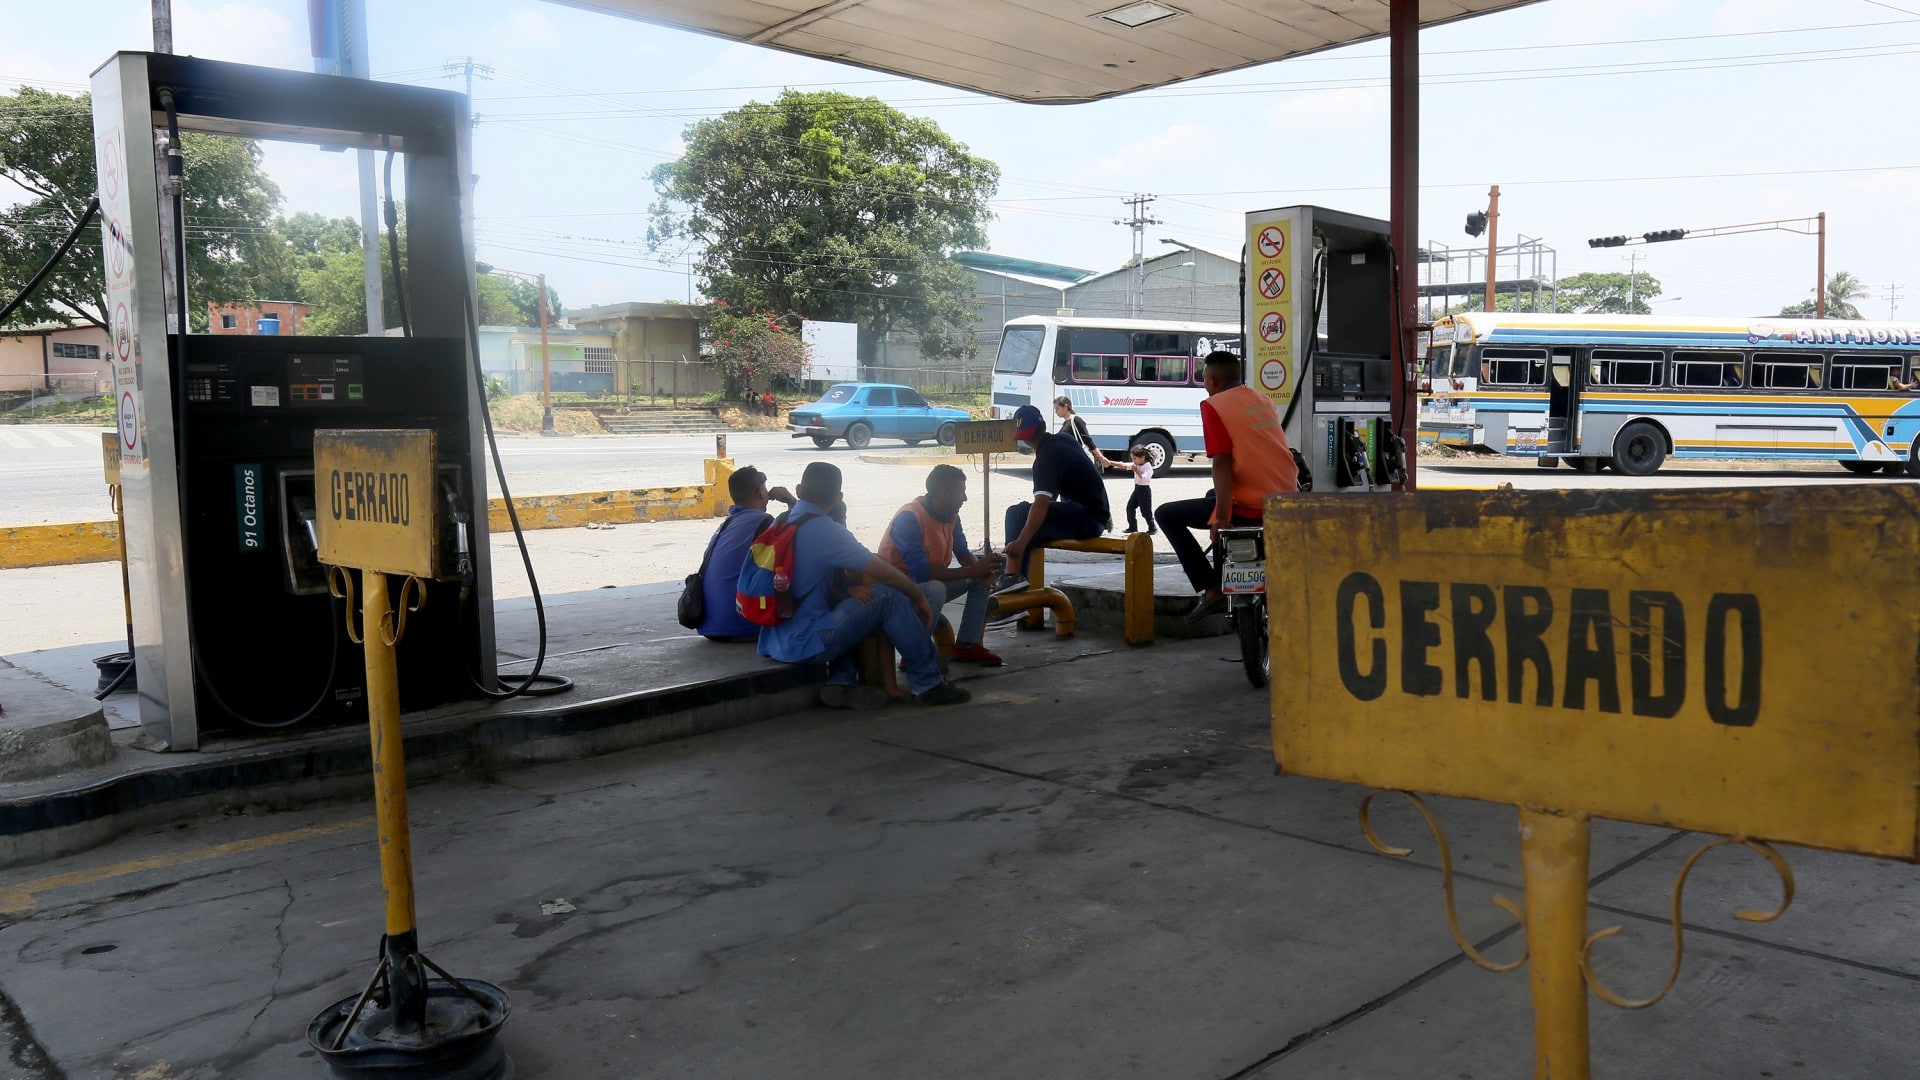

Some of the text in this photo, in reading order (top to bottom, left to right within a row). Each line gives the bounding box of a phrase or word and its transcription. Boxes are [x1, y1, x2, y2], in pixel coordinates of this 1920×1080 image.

[1110, 396, 1135, 406] condor
[964, 429, 1004, 444] CERRADO
[244, 469, 258, 547] 91 Octanos
[331, 469, 410, 527] CERRADO
[1336, 572, 1763, 727] CERRADO
